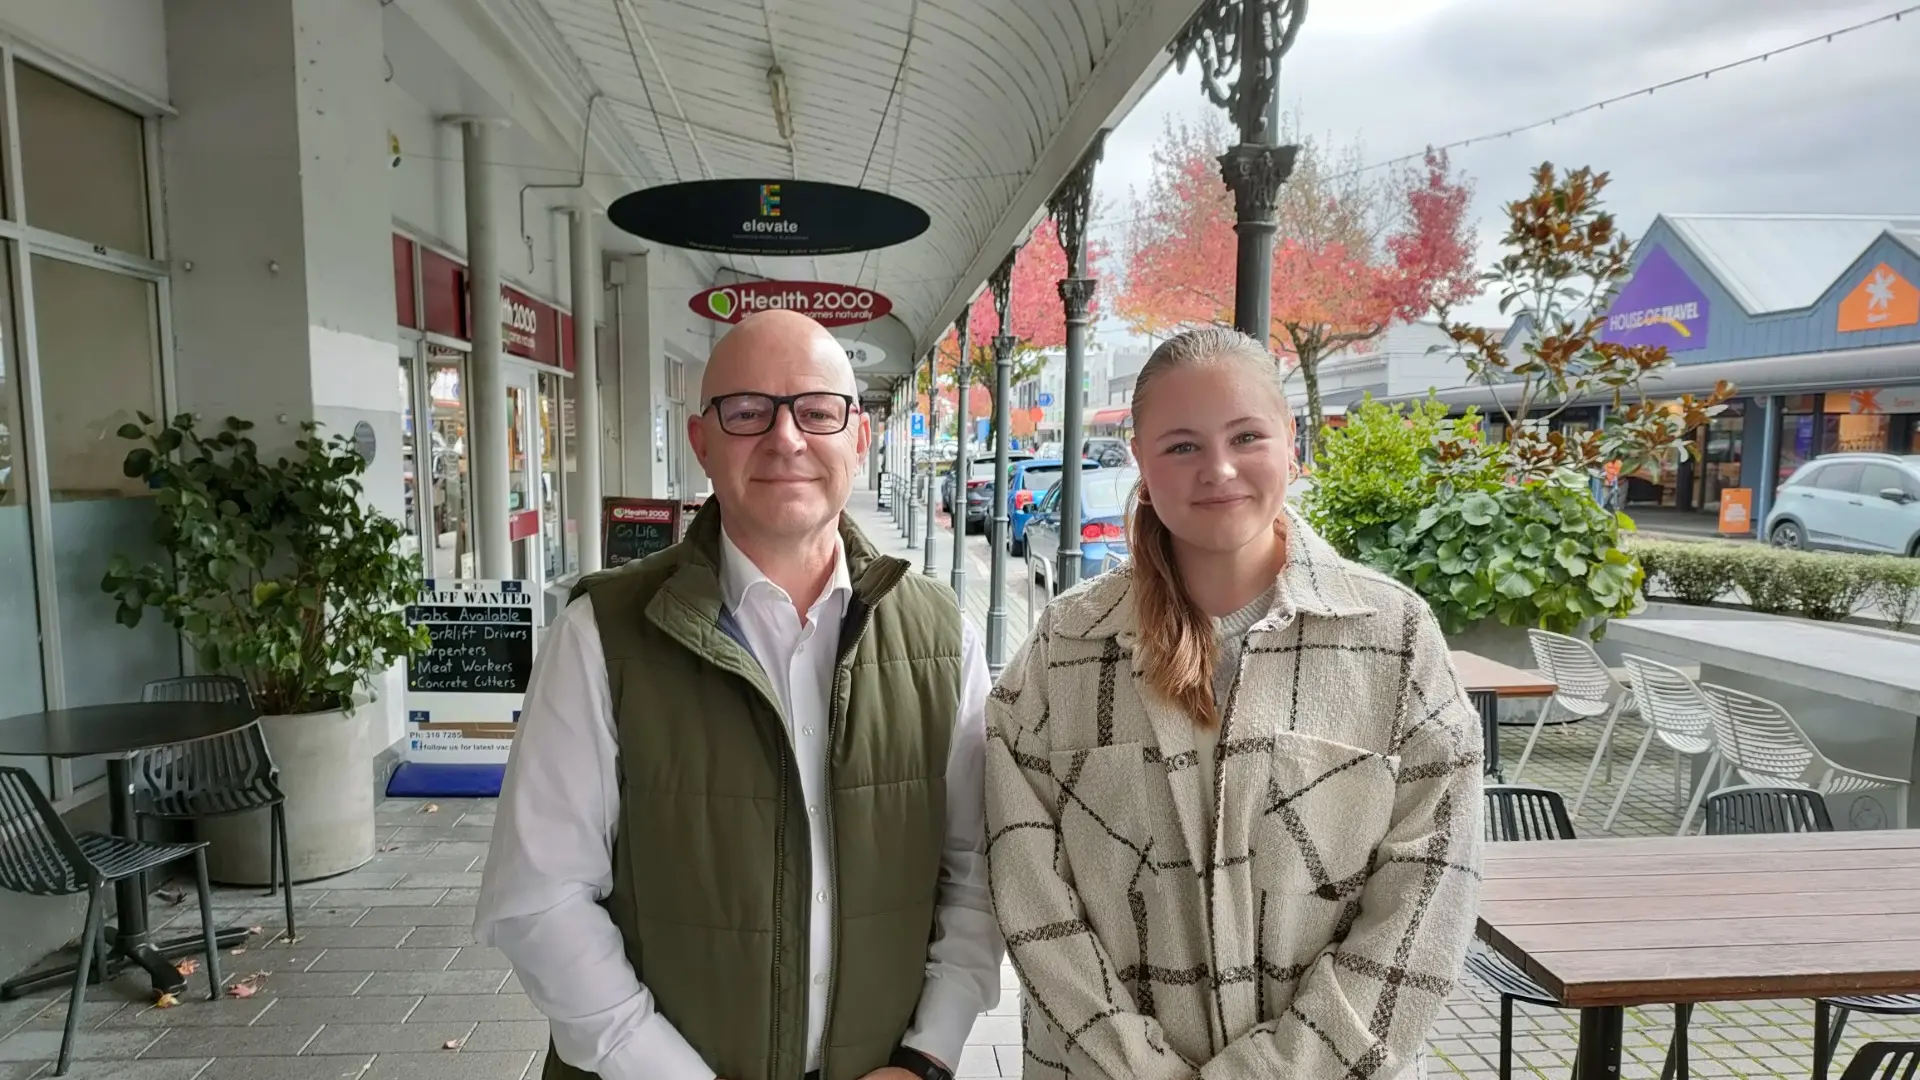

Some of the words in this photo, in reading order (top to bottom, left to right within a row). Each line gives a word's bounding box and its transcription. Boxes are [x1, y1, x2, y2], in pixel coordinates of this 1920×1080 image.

[742, 219, 799, 233] elevate
[741, 290, 809, 310] Health
[813, 292, 874, 309] 2000
[513, 302, 537, 334] 2000
[835, 310, 873, 319] naturally
[1609, 310, 1644, 331] HOUSE
[1645, 307, 1661, 326] OF
[1662, 301, 1700, 321] TRAVEL
[624, 508, 648, 516] Health
[420, 591, 458, 604] TAFF
[463, 592, 531, 605] WANTED
[408, 607, 449, 621] Jobs
[459, 607, 520, 622] Available
[429, 625, 477, 641] orklift
[484, 626, 527, 640] Drivers
[418, 643, 487, 660] arpenters
[417, 659, 453, 674] Meat
[461, 658, 513, 672] Workers
[417, 676, 468, 689] Concrete
[474, 675, 516, 688] Cutters
